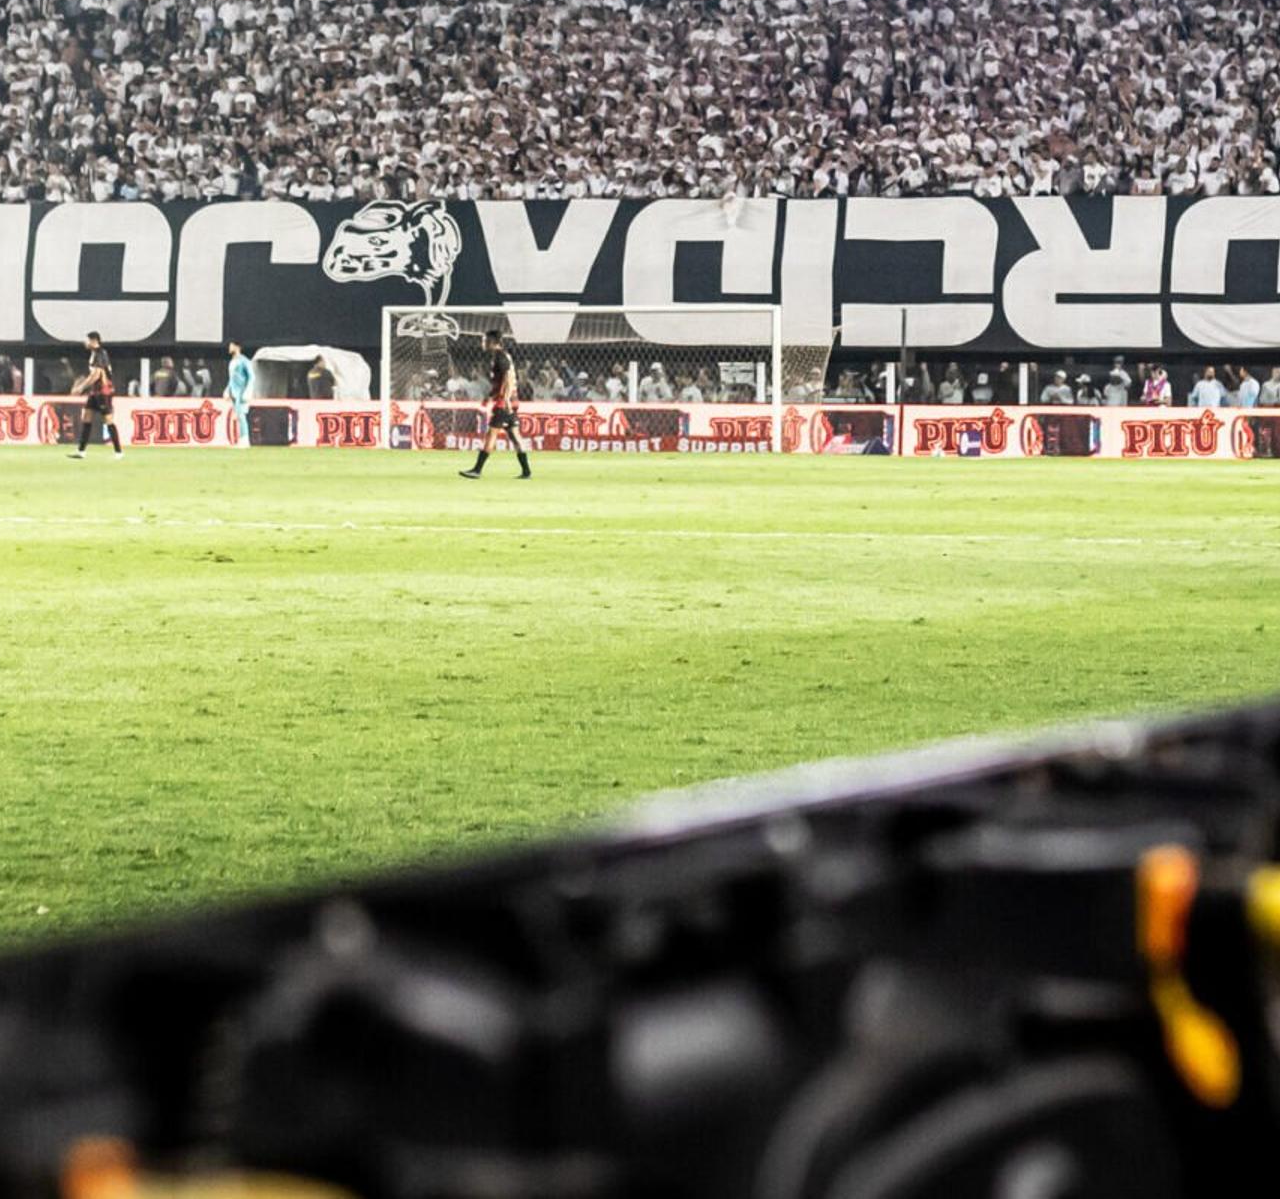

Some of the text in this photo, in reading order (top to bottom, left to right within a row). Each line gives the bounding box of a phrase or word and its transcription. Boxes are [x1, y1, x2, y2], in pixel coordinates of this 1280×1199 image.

[131, 400, 221, 445] PITÚ
[560, 435, 662, 453] SUPERBET
[677, 438, 768, 453] SUPERBE
[1122, 410, 1224, 457] PITÚ
